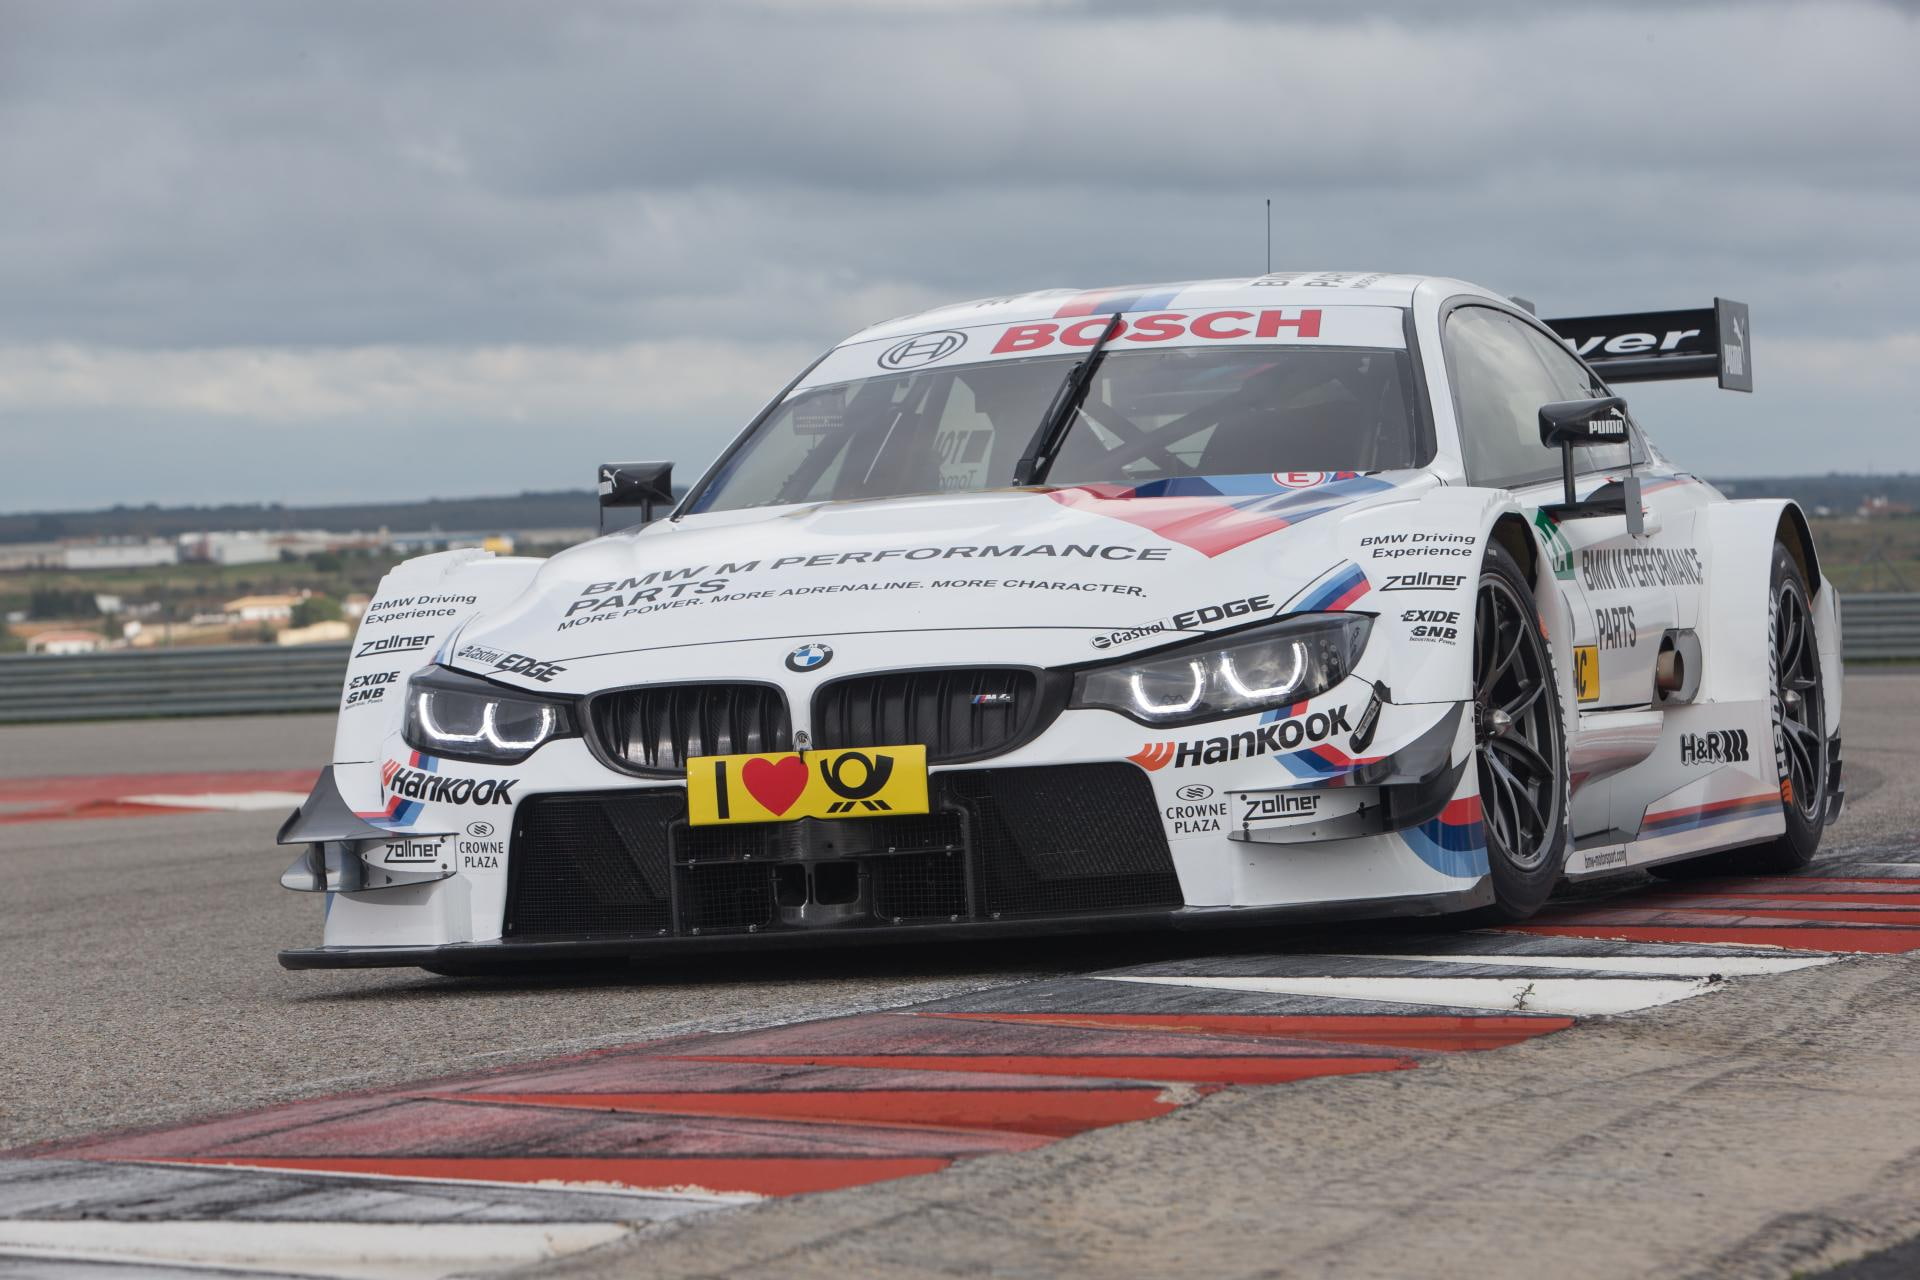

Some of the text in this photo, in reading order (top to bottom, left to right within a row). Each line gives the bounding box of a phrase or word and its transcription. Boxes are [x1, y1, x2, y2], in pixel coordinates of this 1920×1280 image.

[991, 309, 1322, 354] BOSCH
[1589, 420, 1624, 434] PUMA
[1360, 533, 1476, 546] BMW Driving
[1372, 546, 1472, 558] Experience
[581, 544, 1172, 596] BMW M PERFORMANCE
[1582, 548, 1704, 591] BMW M PERFORMANCE
[1379, 572, 1467, 591] zollner
[370, 594, 477, 612] BMW Driving
[557, 579, 1147, 632] MORE POWER. MORE ADRENALINE. MORE CHARACTER.
[564, 578, 730, 617] PARTS
[365, 608, 456, 624] Experience
[1111, 595, 1275, 646] Castrol EDGE
[1400, 610, 1461, 625] EXIDE
[1411, 626, 1458, 639] GNB
[1595, 605, 1637, 650] PARTS
[355, 635, 435, 658] zollner
[494, 653, 568, 683] EDGE
[349, 671, 400, 690] EXIDE
[346, 688, 386, 704] GNB
[1680, 731, 1724, 766] H&R
[715, 761, 731, 820] I
[1166, 802, 1228, 820] CROWNE
[1243, 794, 1322, 821] zollner
[1175, 819, 1221, 834] PLAZA
[384, 840, 444, 864] zollner
[459, 842, 505, 854] CROWNE
[465, 856, 499, 868] PLAZA
